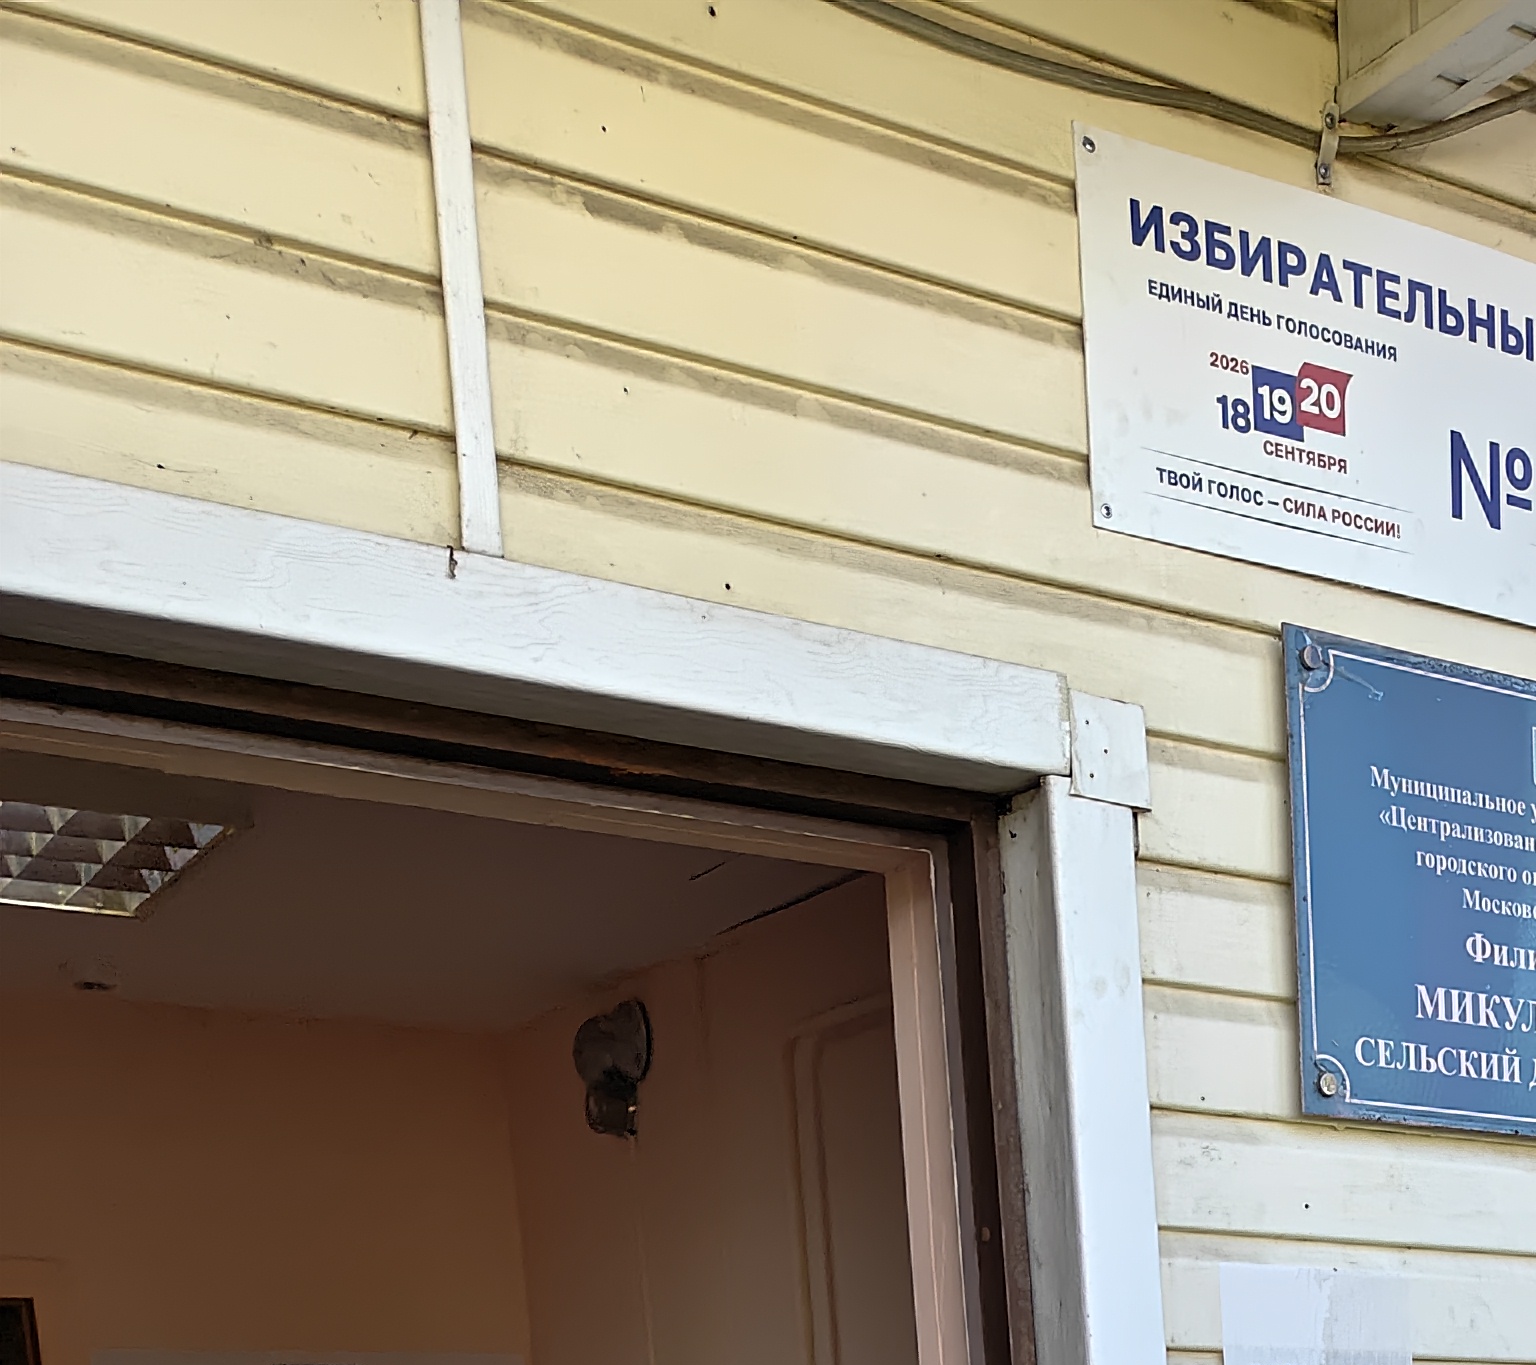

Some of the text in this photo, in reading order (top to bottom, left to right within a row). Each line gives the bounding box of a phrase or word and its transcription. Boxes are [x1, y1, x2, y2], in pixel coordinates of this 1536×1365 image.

[1147, 279, 1398, 362] ЕДИНЫЙ ДЕНЬ ГОЛОСОВАНИЯ
[1209, 351, 1249, 376] 2026
[1216, 375, 1341, 434] 18 19 20
[1262, 439, 1349, 475] СЕНТЯБРЯ
[1449, 430, 1533, 531] №
[1155, 465, 1203, 494] ТВОЙ
[1207, 477, 1265, 507] ГОЛОС
[1282, 497, 1328, 522] СИЛА
[1331, 507, 1402, 540] РОССИИ!
[1370, 765, 1526, 818] Муниципальное
[1416, 849, 1517, 886] городского
[1355, 1036, 1522, 1085] СЕЛЬСКИЙ
